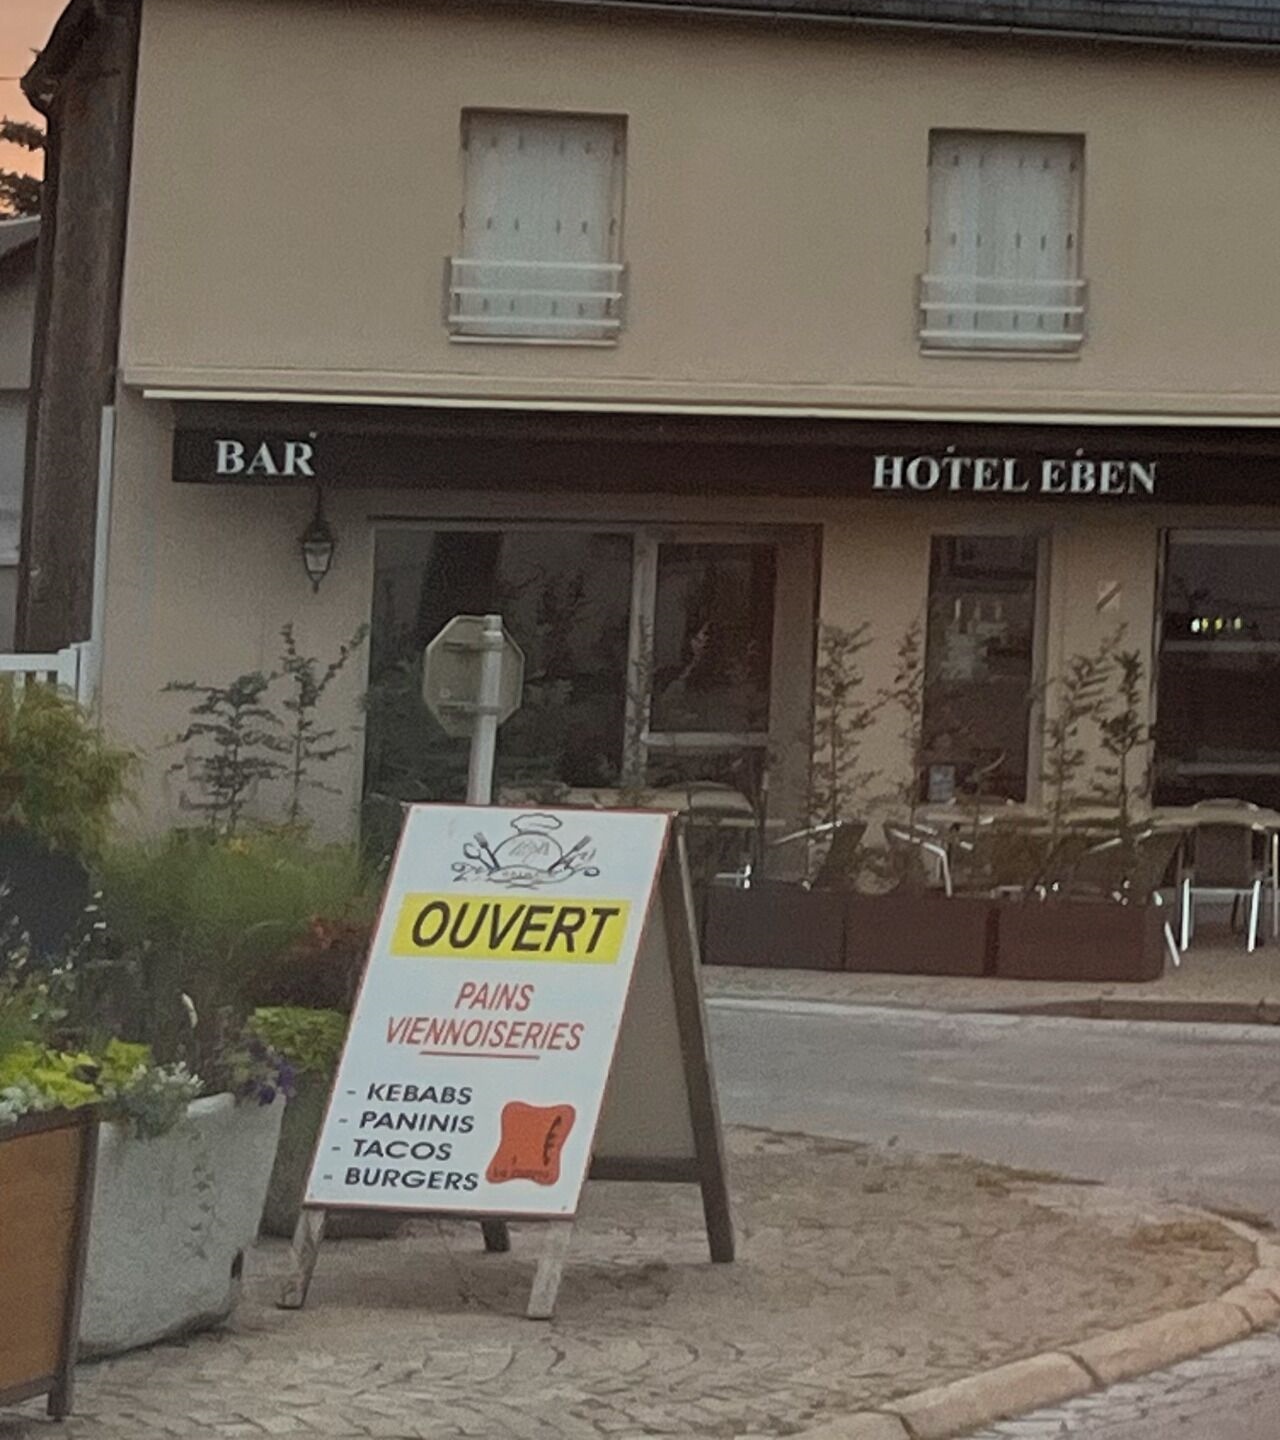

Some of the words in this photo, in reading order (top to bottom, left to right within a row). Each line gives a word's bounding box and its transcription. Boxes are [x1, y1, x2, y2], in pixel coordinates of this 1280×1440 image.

[215, 439, 316, 476] BAR
[872, 455, 1030, 492] HOTEL
[1040, 459, 1157, 494] EBEN
[411, 901, 620, 954] OUVERT
[454, 981, 534, 1012] PAINS
[385, 1016, 585, 1051] VIENNOISERIES
[366, 1082, 473, 1105] KEBABS
[358, 1110, 475, 1134] PANINIS
[352, 1138, 453, 1161] TACOS
[344, 1166, 480, 1192] BURGERS
